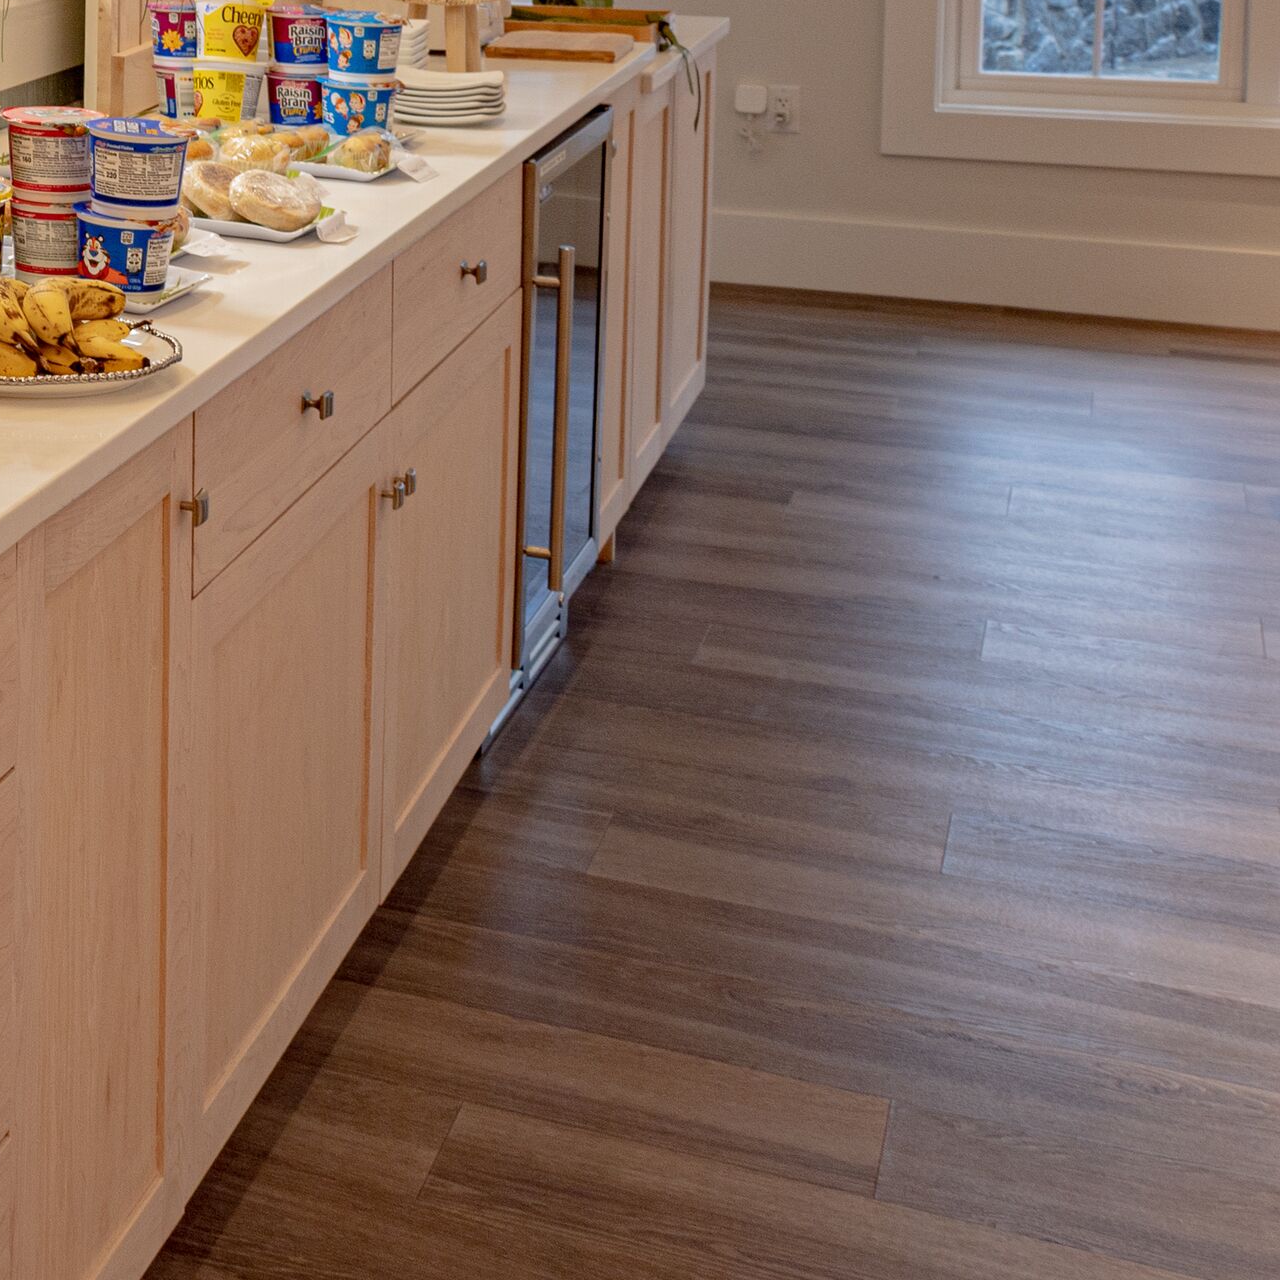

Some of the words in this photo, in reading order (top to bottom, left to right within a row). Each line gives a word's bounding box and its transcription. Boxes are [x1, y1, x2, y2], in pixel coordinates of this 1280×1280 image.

[221, 5, 262, 27] Cheeri
[288, 24, 326, 38] Raisin
[293, 36, 322, 49] Bran
[276, 85, 312, 101] Raisin
[280, 97, 308, 109] Bran
